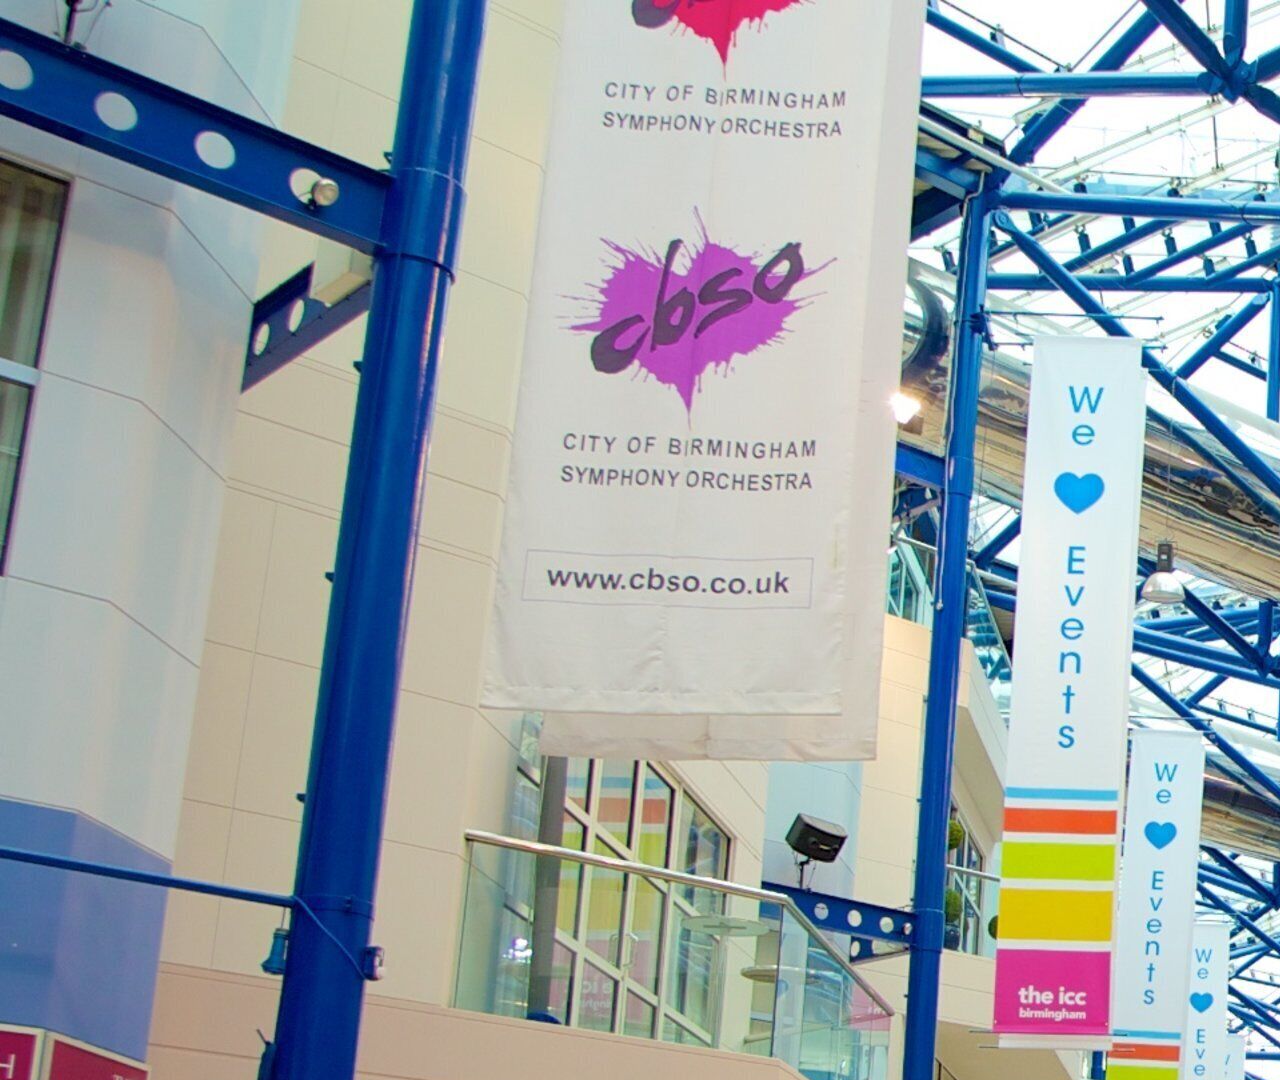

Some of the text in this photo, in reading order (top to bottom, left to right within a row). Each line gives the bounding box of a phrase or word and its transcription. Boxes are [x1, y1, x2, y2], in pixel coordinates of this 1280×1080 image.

[604, 82, 847, 110] CITY OF BIRMINGHAM
[602, 111, 843, 138] SYMPHONY ORCHESTRA
[590, 238, 804, 374] cbso
[562, 432, 817, 460] CITY OF BIRMINGHAM
[560, 465, 813, 492] SYMPHONY ORCHESTRA
[546, 564, 790, 596] www.cbso.co.uk
[1057, 385, 1104, 750] We Events
[1142, 763, 1178, 1006] We Events
[1195, 948, 1213, 979] We
[1018, 986, 1086, 1007] the icc
[1018, 1006, 1086, 1022] birmingham
